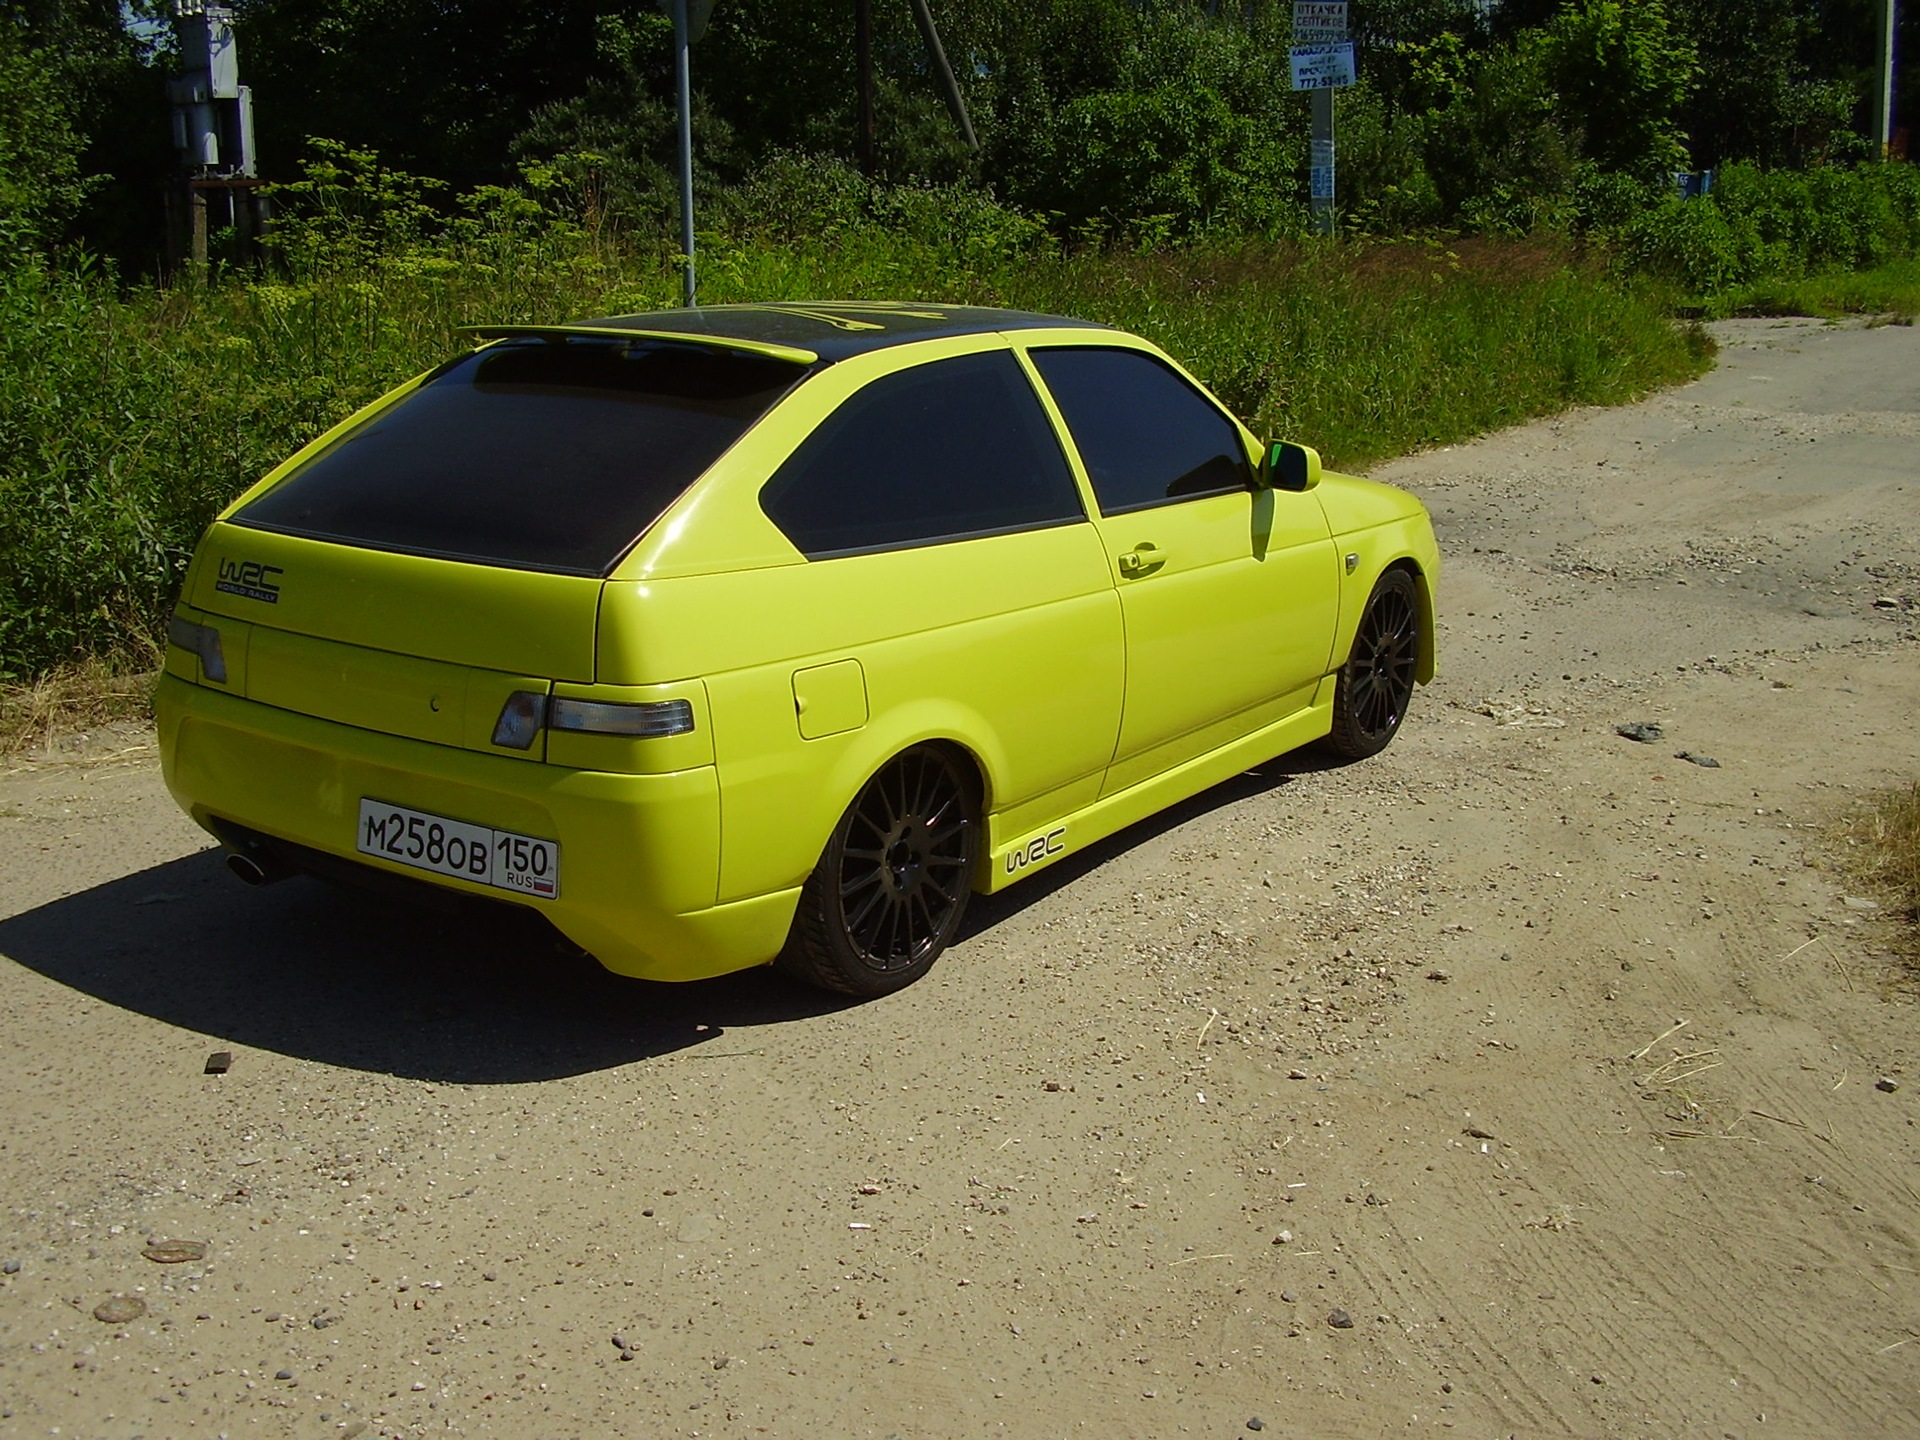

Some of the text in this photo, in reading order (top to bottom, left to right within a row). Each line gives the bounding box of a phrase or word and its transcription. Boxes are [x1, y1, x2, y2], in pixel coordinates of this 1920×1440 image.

[1298, 4, 1343, 15] ОТКАЧКА
[1296, 16, 1344, 27] СЕПТИКОВ
[219, 557, 284, 592] WRC
[216, 582, 276, 602] WORLD RALLY
[366, 813, 548, 876] М258ОВ 150
[1006, 827, 1066, 874] WRC
[506, 871, 533, 889] RUS
